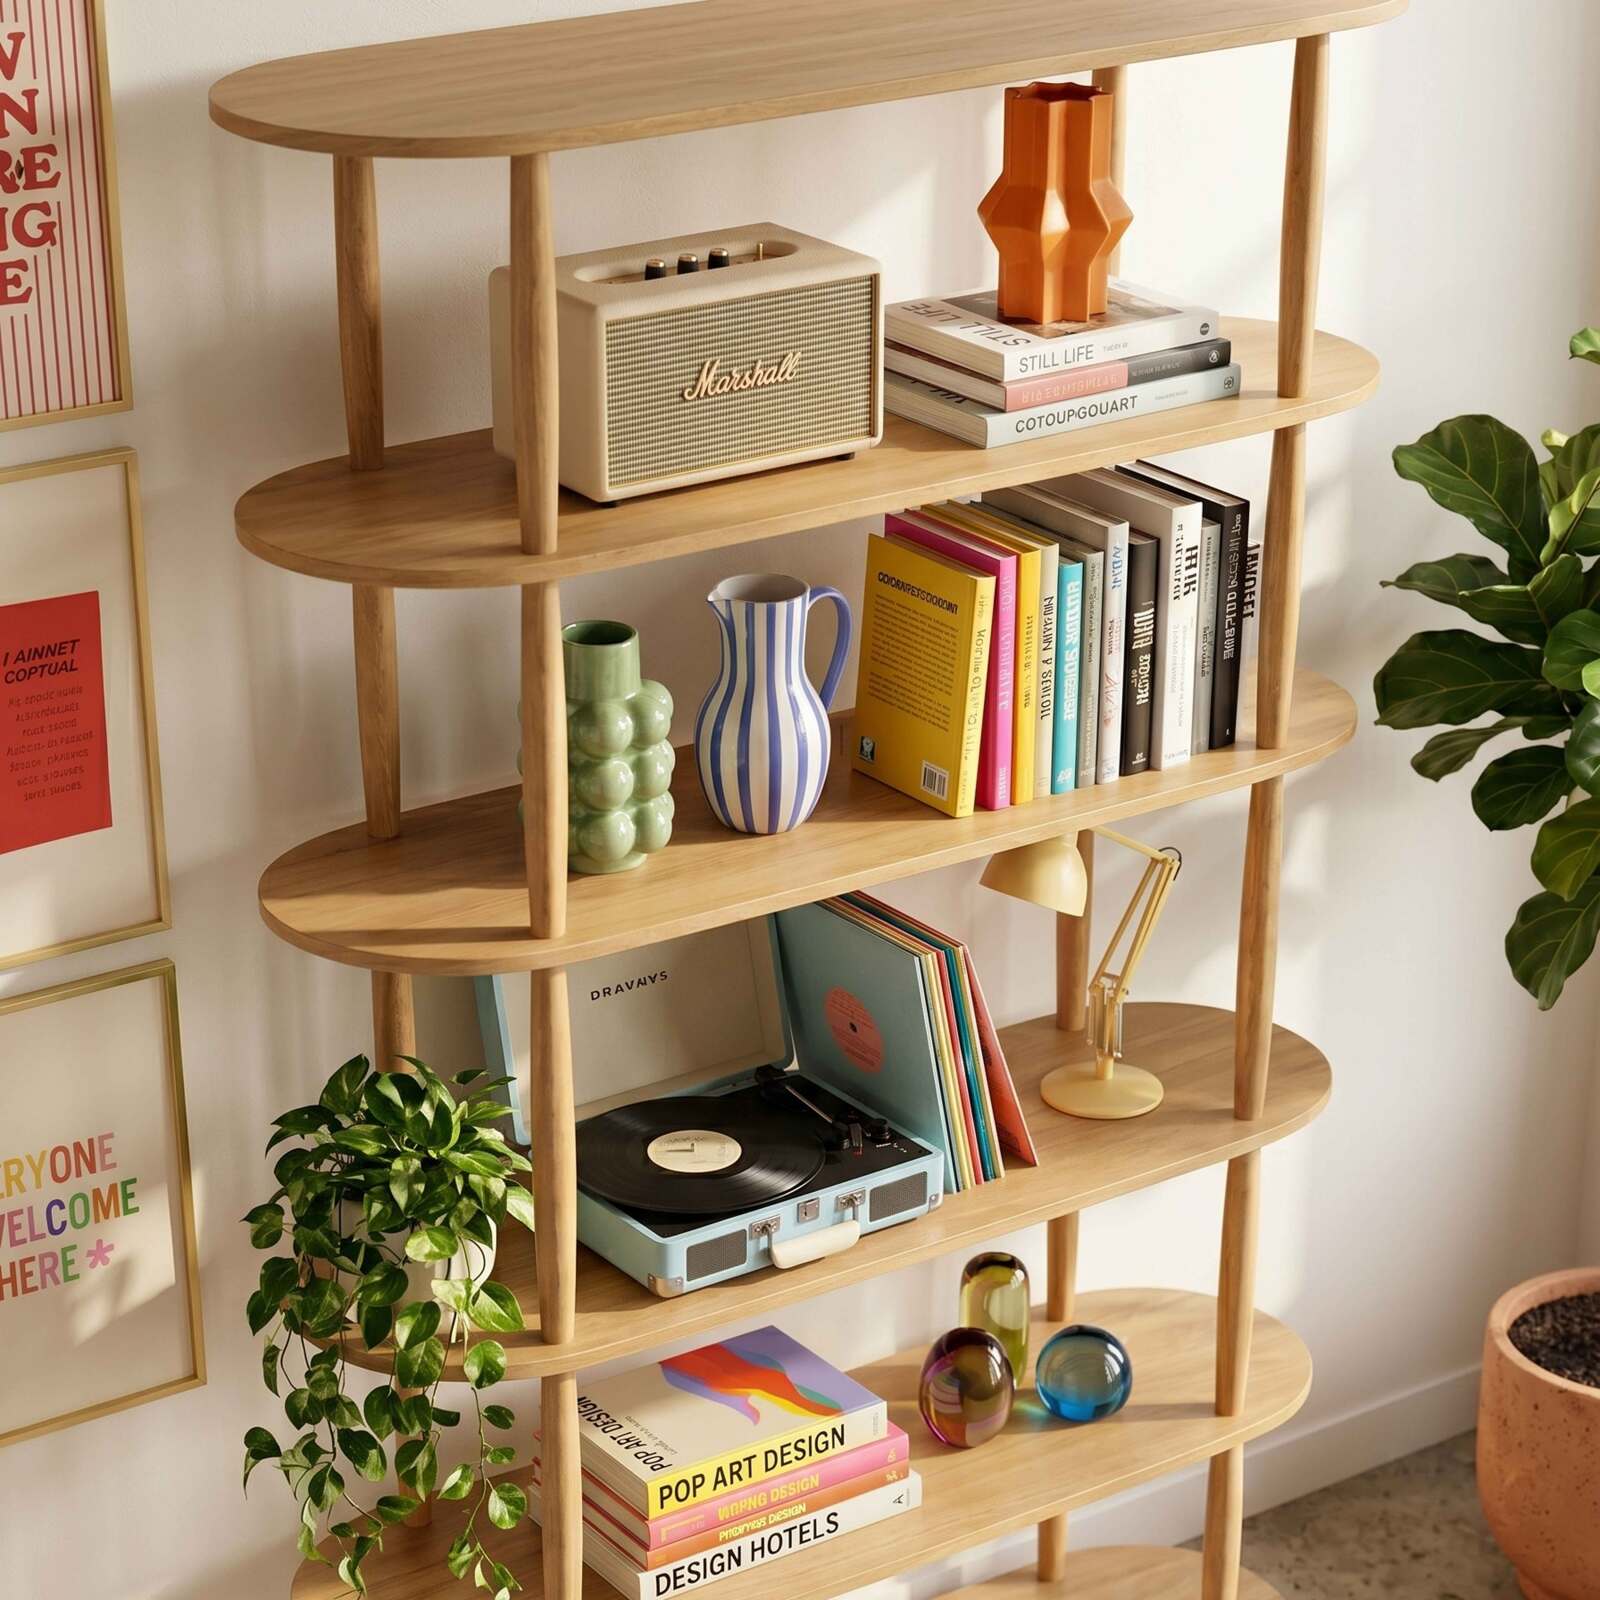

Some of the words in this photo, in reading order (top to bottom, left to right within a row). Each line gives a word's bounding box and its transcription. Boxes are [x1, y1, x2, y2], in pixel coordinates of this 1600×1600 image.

[901, 303, 961, 322] LIFE
[959, 321, 1031, 347] STILL
[1018, 351, 1060, 374] STILL
[1064, 344, 1095, 365] LIFE
[683, 351, 802, 401] Marshall
[3, 651, 11, 668] I
[4, 658, 79, 685] COPTUAL
[0, 1131, 118, 1200] RYONE
[0, 1177, 141, 1249] ELCOME
[609, 1431, 647, 1450] ART
[633, 1451, 673, 1472] POP
[659, 1473, 706, 1510] POP
[712, 1454, 757, 1491] ART
[764, 1423, 847, 1474] DESIGN
[655, 1545, 743, 1597] DESIGN
[750, 1511, 840, 1563] HOTELS
